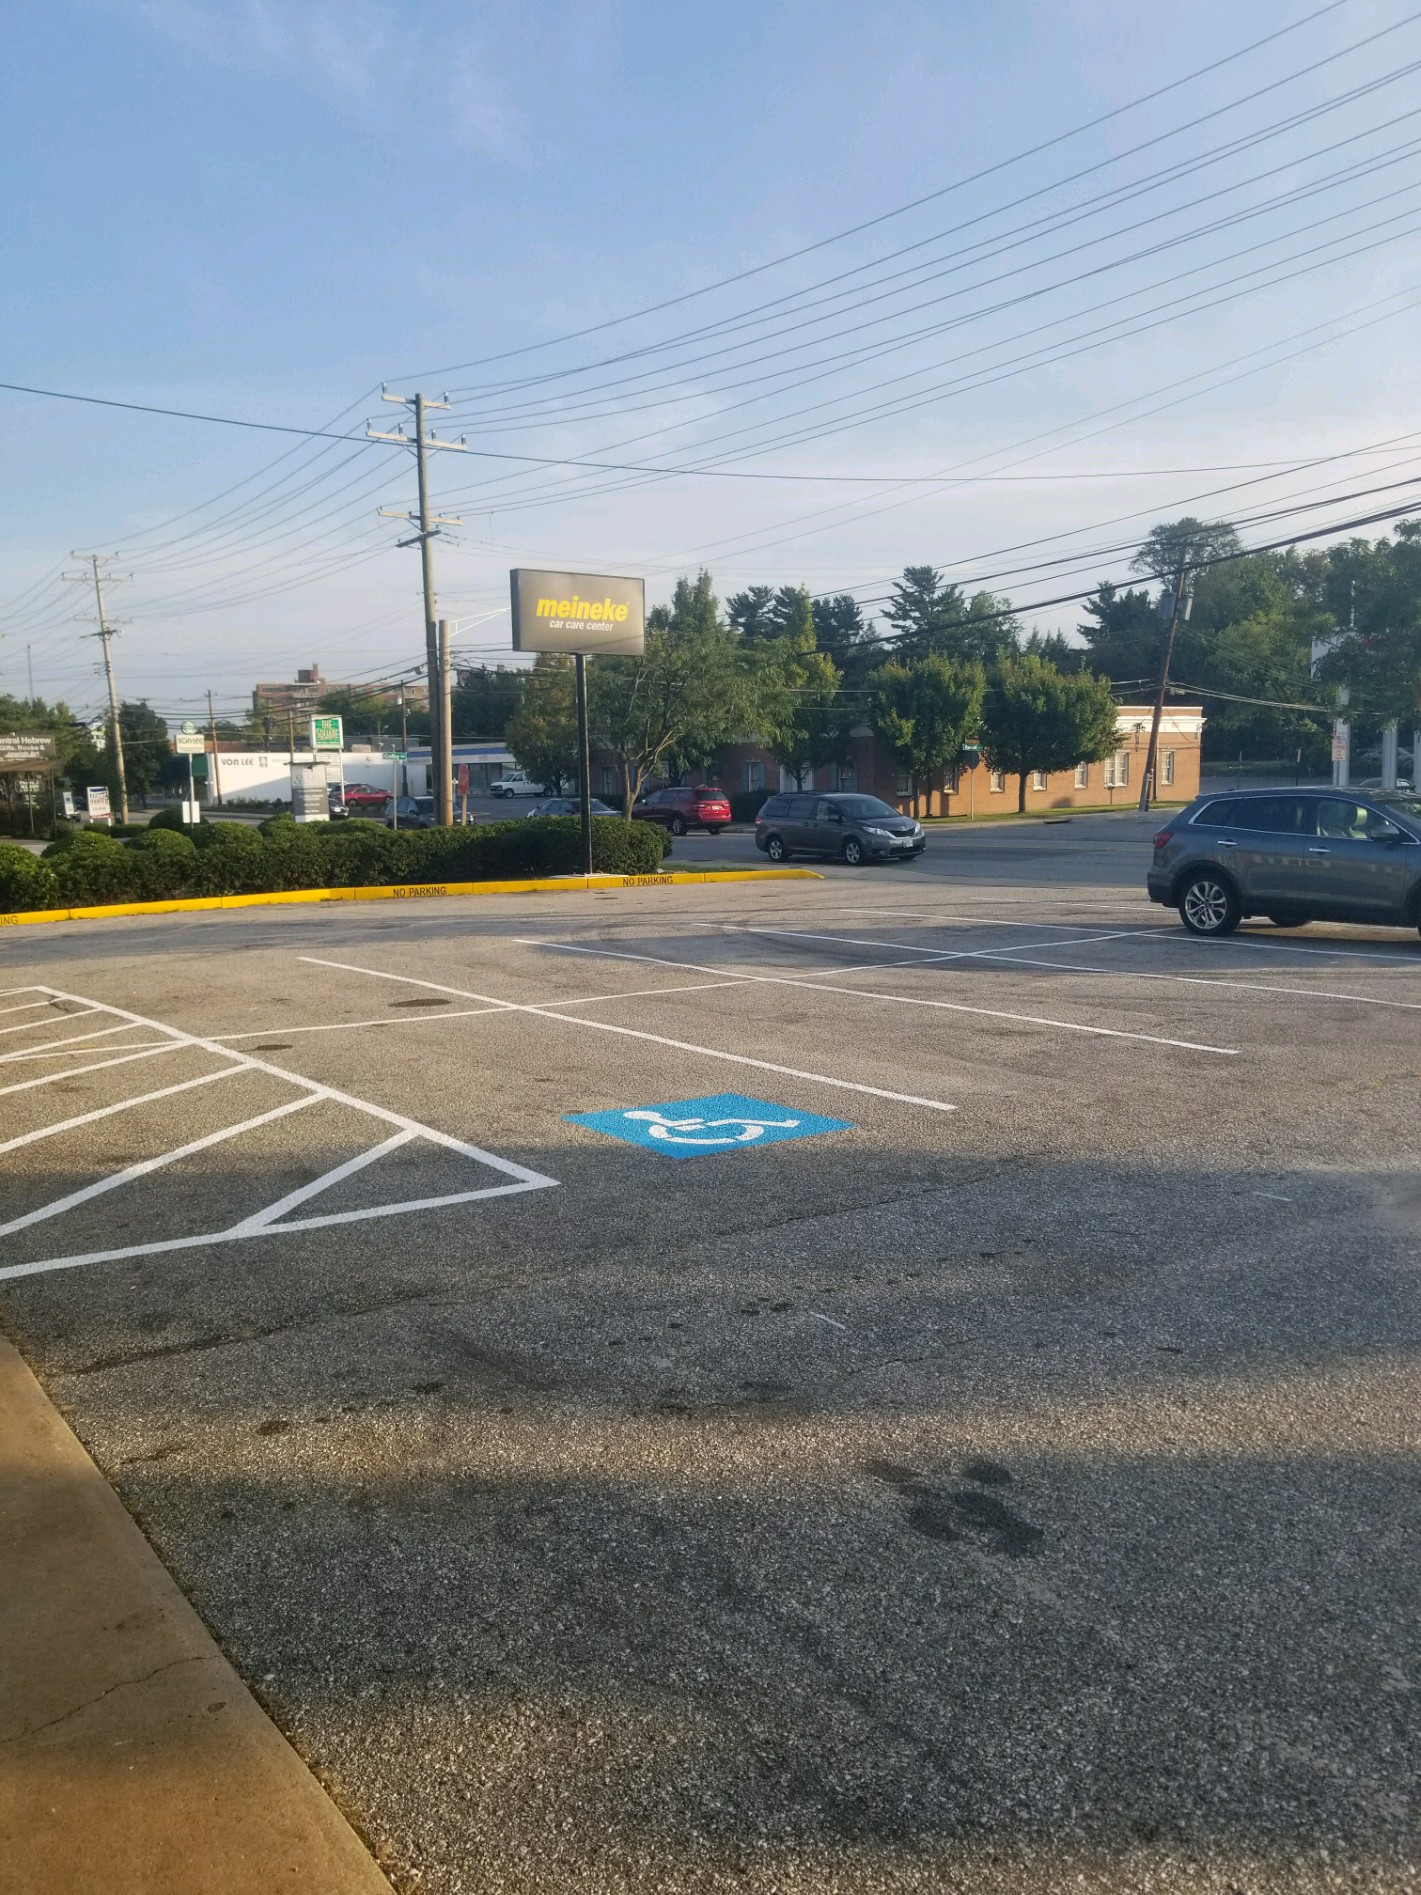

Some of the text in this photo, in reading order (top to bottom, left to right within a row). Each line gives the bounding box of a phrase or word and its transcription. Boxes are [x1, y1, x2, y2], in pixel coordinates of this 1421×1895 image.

[536, 595, 629, 622] meineke
[549, 620, 613, 632] car care center
[21, 736, 51, 744] Hebrew
[241, 758, 254, 766] LEE
[622, 876, 673, 887] NO PARKING
[393, 886, 447, 897] NO PARKING
